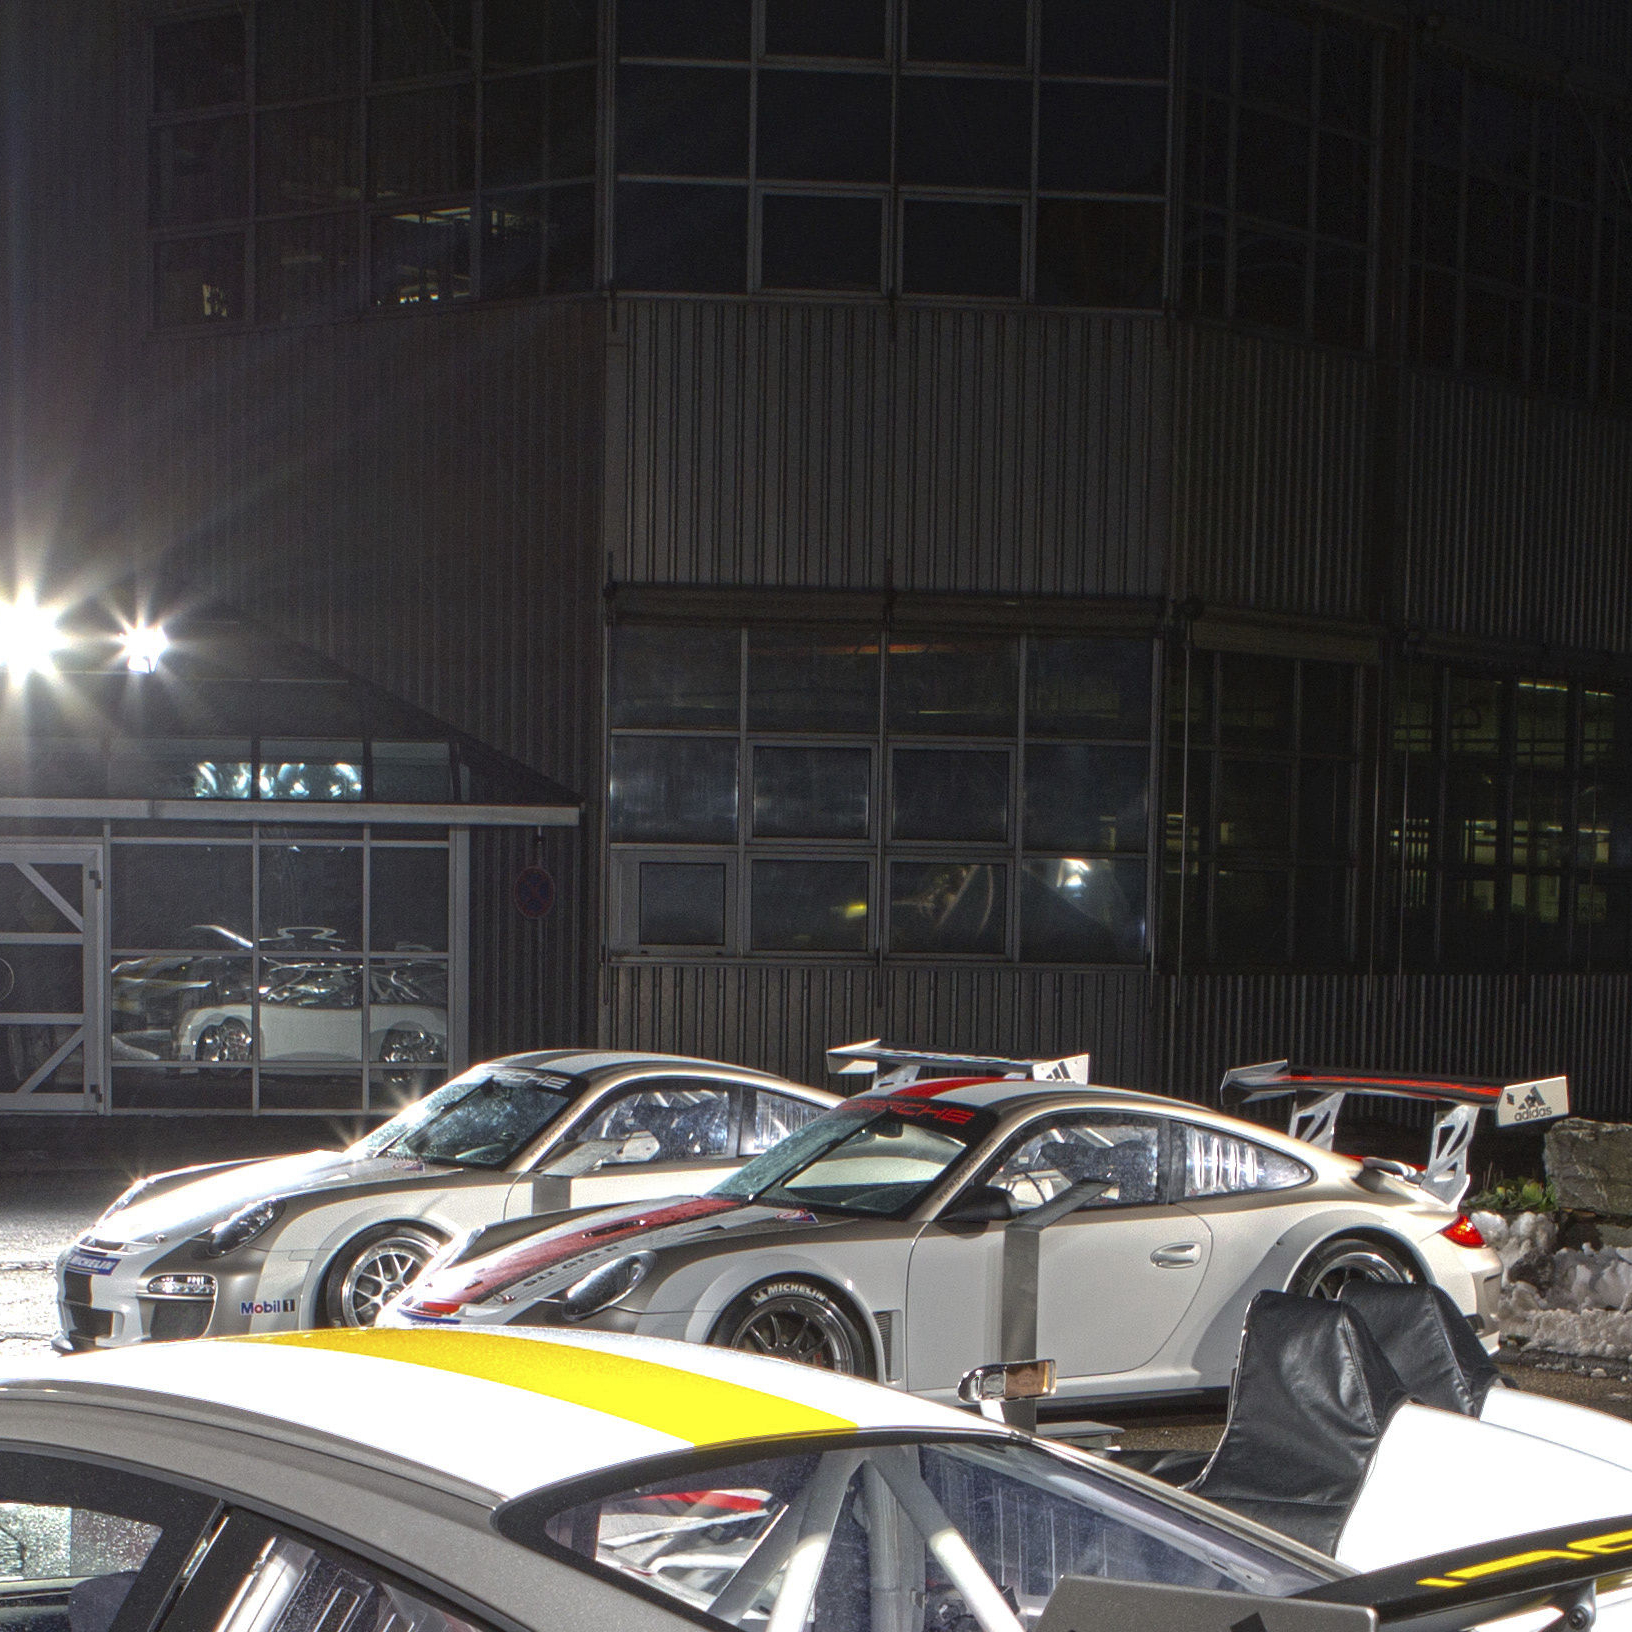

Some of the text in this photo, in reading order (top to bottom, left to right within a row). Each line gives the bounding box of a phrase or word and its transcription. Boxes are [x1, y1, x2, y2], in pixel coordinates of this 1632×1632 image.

[1514, 1105, 1553, 1121] adidas
[768, 1282, 829, 1303] MICHELIN
[240, 1300, 281, 1315] Mobil
